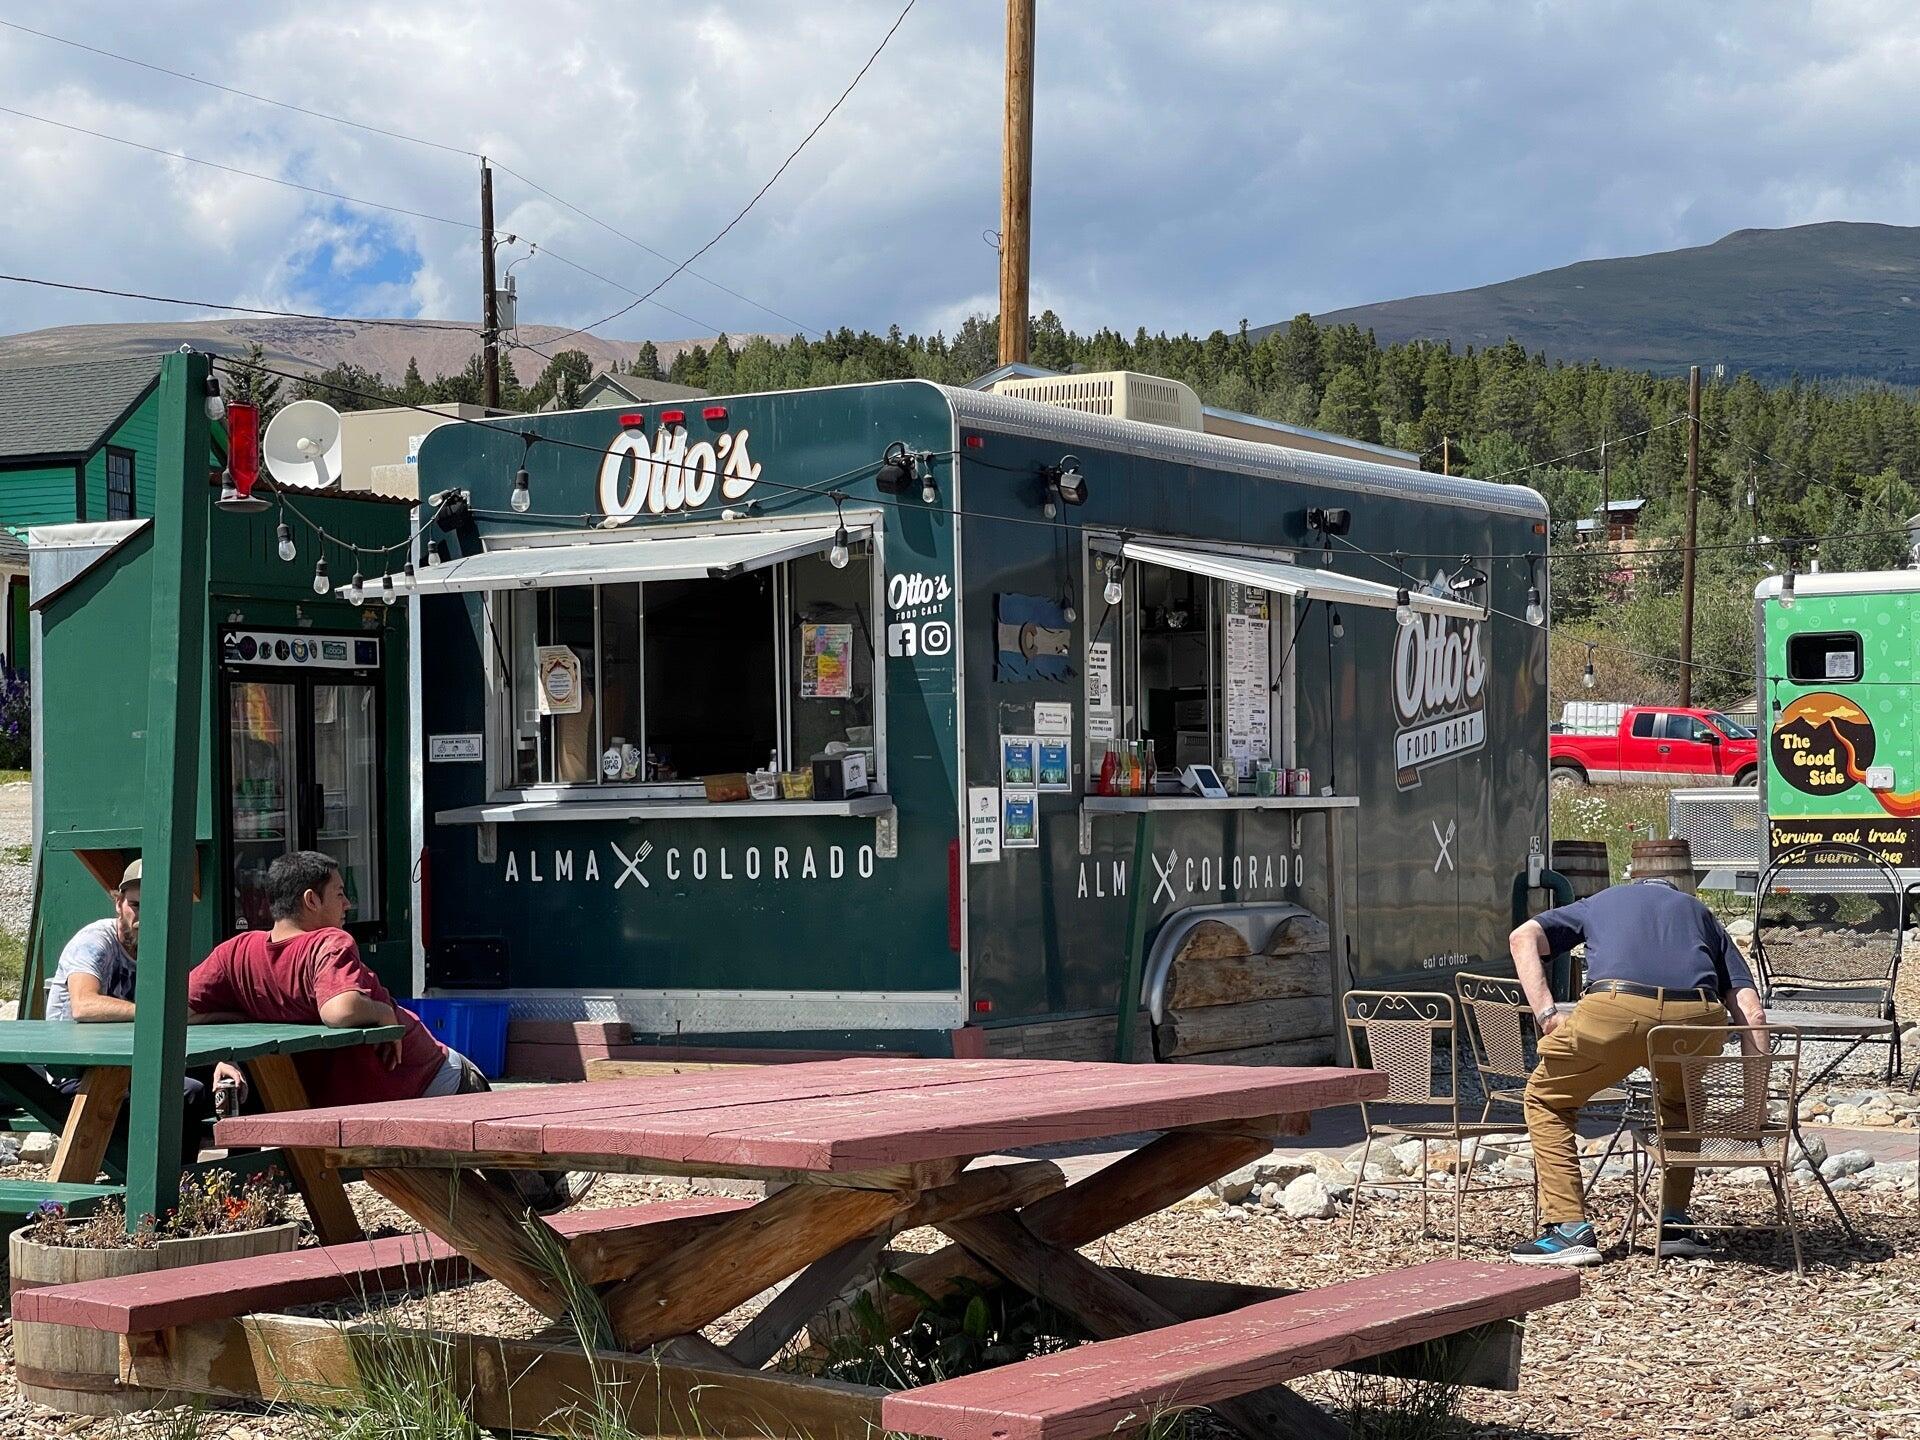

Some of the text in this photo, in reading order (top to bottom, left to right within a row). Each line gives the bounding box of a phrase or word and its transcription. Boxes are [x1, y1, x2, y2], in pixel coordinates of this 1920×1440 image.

[599, 424, 762, 525] Otto's
[888, 572, 952, 610] Otto's
[896, 604, 943, 621] FOOD CART
[1395, 611, 1486, 720] Otto's
[1407, 717, 1475, 762] FOOD CART
[1780, 733, 1811, 749] The
[1793, 748, 1835, 766] Good
[1809, 766, 1845, 785] Side
[1530, 837, 1540, 853] 45
[1832, 828, 1860, 842] cool
[1867, 827, 1908, 844] treats
[505, 844, 874, 882] ALMA COLORADO
[1077, 854, 1303, 899] ALM COLORADO
[1423, 952, 1468, 969] eat at ottos
